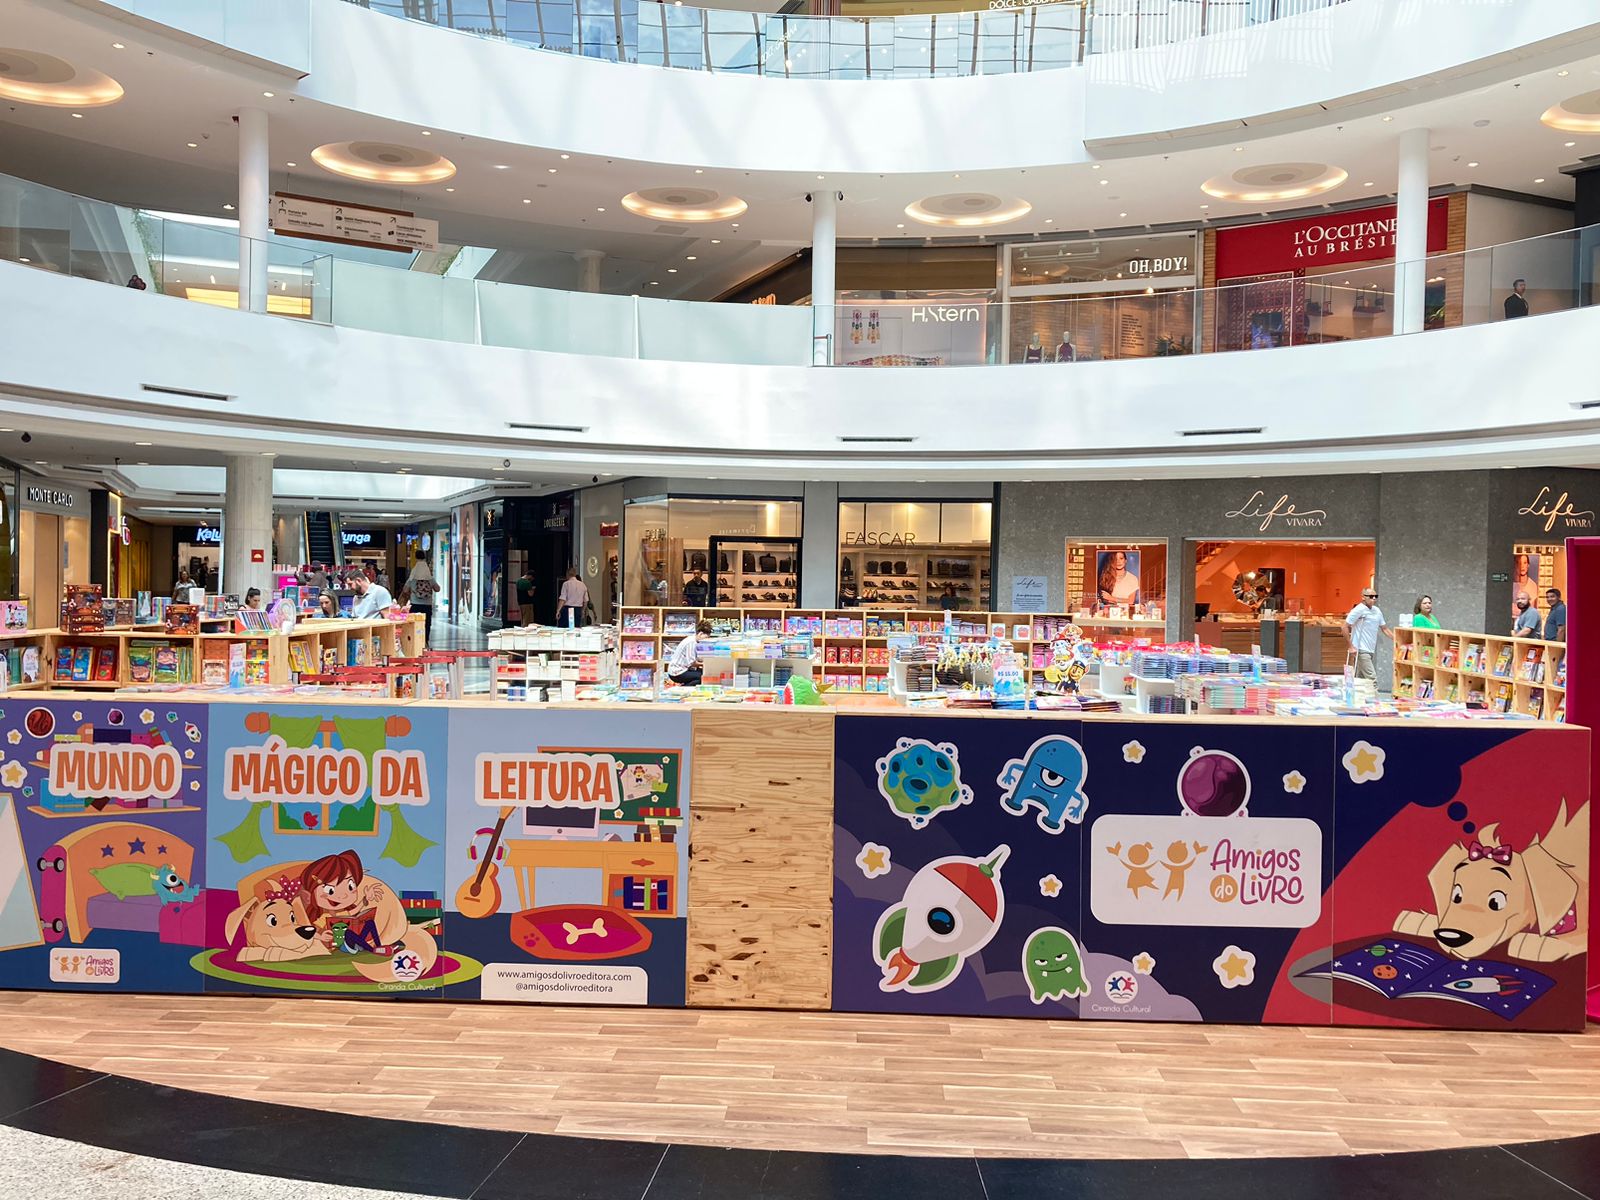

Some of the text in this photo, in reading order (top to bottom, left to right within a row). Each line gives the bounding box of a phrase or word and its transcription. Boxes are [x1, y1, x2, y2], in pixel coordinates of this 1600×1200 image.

[1294, 245, 1318, 258] AU
[28, 487, 73, 508] MONTE CARLO
[1224, 490, 1327, 531] Life
[1518, 486, 1595, 532] Life
[1286, 518, 1322, 526] VIVARA
[1565, 518, 1592, 528] VIVARA
[845, 531, 916, 546] FASCAR
[56, 743, 614, 803] MUNDO MÁGICO DA LEITURA
[1214, 877, 1234, 900] do
[497, 970, 632, 982] www.amigosdolivroeditora.com
[515, 982, 613, 993] @amigosdolivroeditora
[1091, 1004, 1152, 1013] Ciranda Cultural
